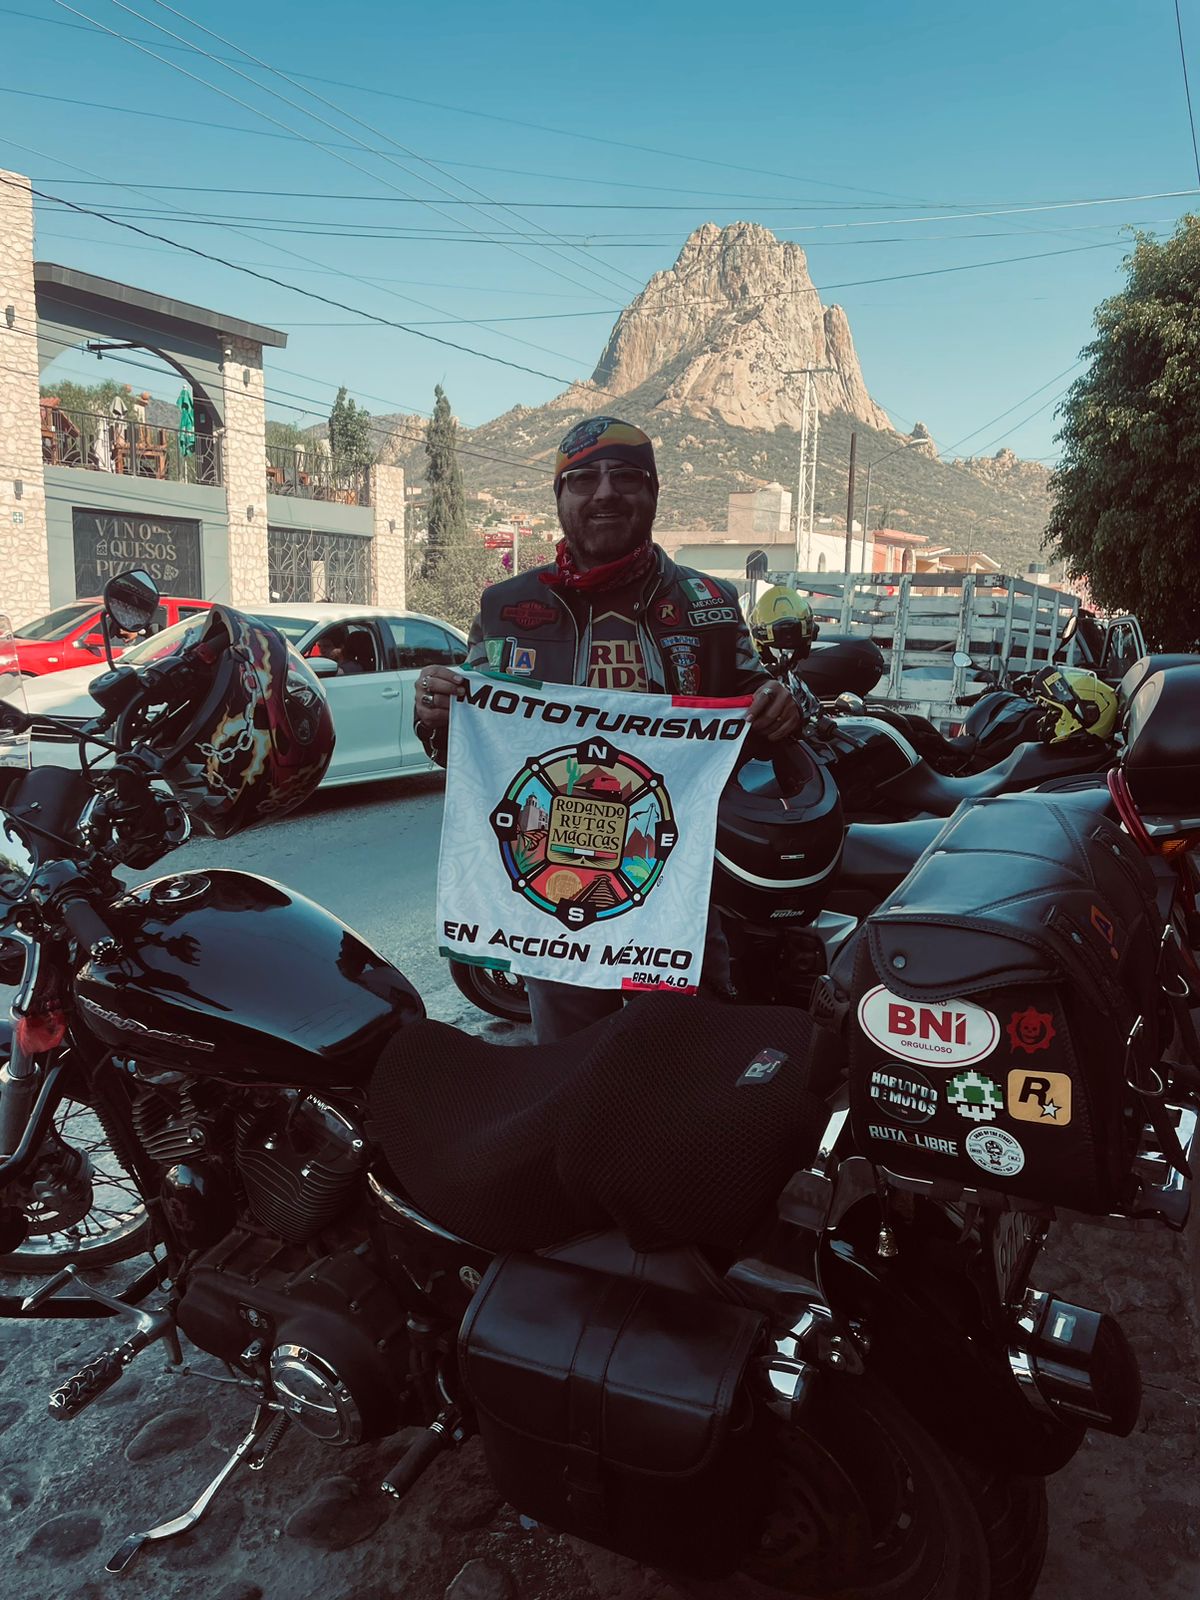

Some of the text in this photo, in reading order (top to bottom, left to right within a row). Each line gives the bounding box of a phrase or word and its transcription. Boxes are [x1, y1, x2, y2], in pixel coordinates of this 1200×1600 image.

[95, 519, 152, 540] VINO
[110, 540, 177, 561] QUESOS
[692, 598, 725, 609] MEXICO
[693, 609, 734, 623] ROD
[455, 678, 747, 741] MOTOTURISMO
[587, 744, 608, 760] N
[496, 812, 514, 827] O
[660, 833, 675, 847] E
[567, 907, 585, 922] S
[443, 920, 693, 970] EN ACCIÓN MÉXICO
[665, 974, 689, 988] 4.0
[900, 1039, 953, 1054] ORGULLOSO
[871, 1071, 938, 1101] HABLANDO
[1018, 1076, 1051, 1107] R
[889, 1090, 937, 1116] MOTOS
[868, 1125, 959, 1156] RUTA LIBRE
